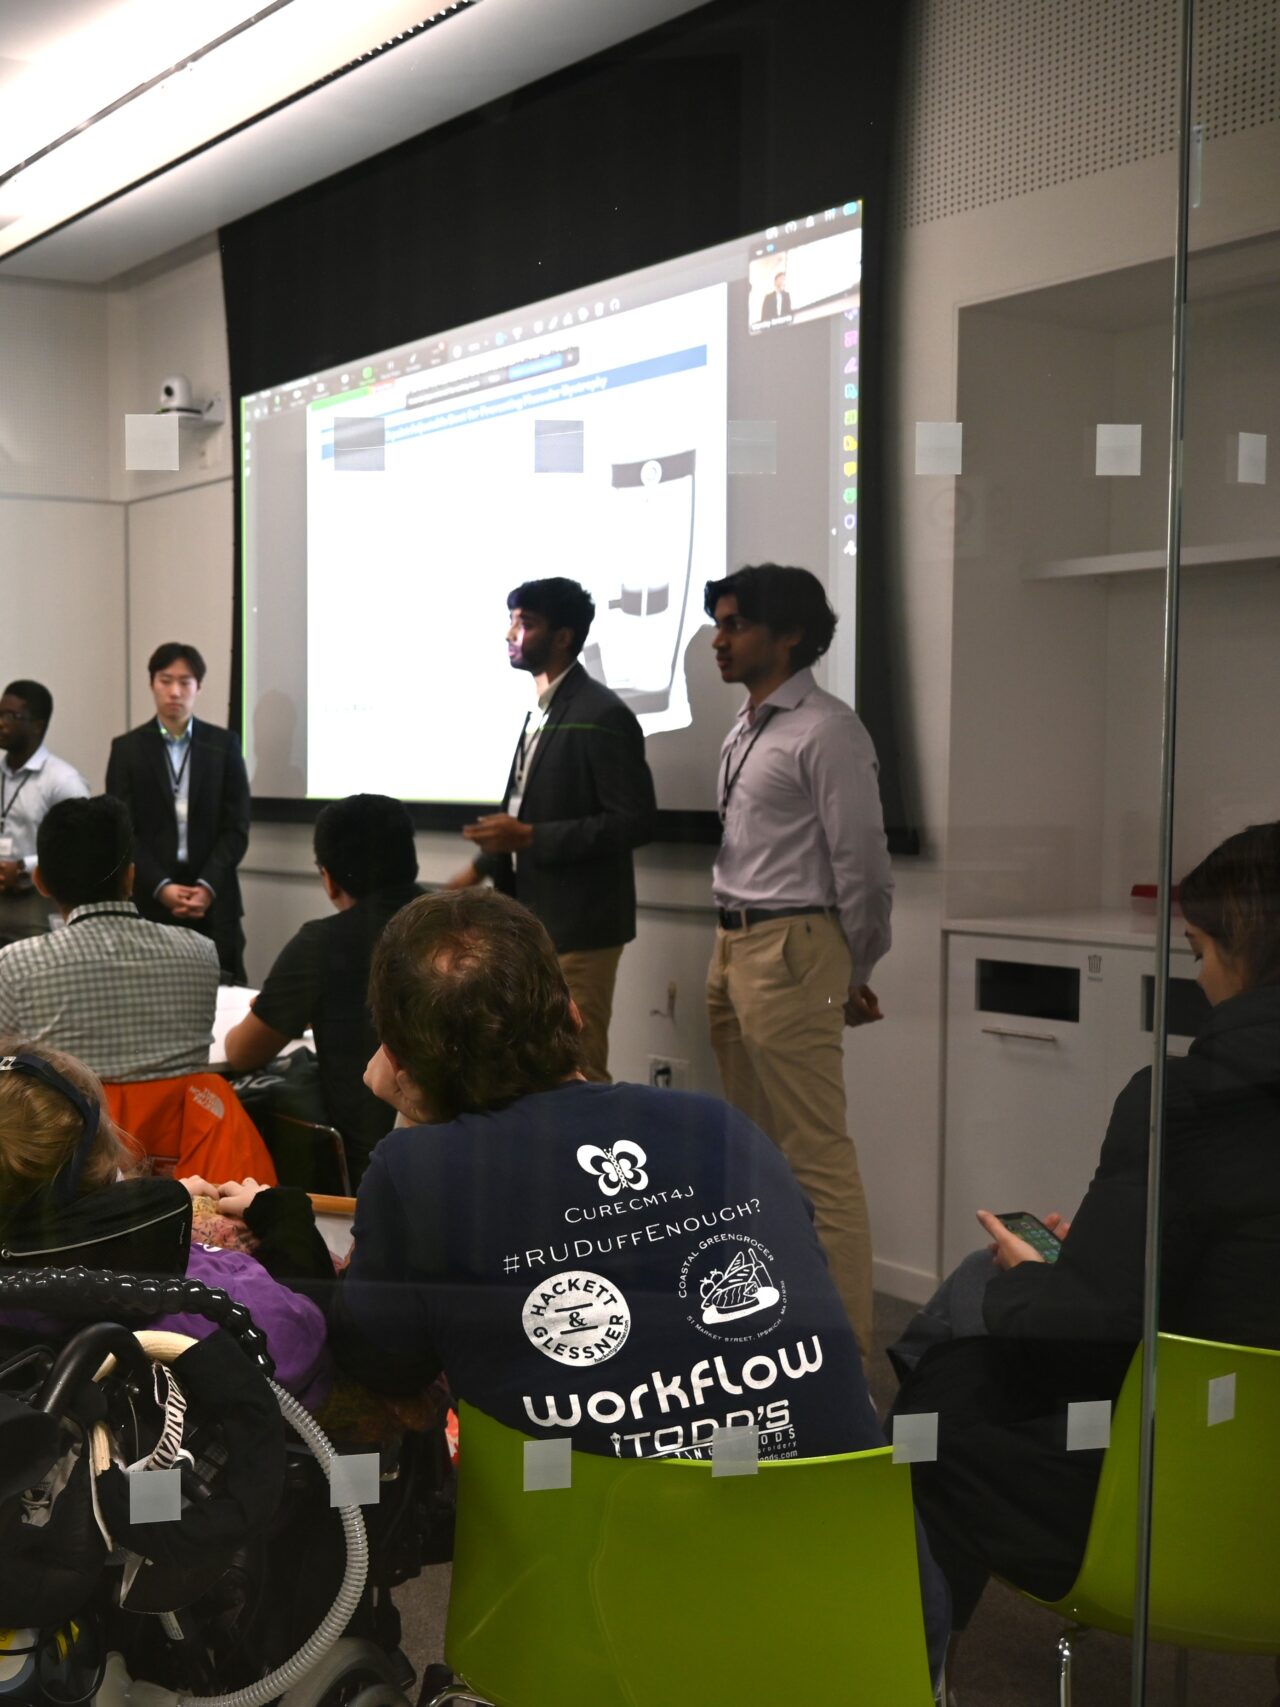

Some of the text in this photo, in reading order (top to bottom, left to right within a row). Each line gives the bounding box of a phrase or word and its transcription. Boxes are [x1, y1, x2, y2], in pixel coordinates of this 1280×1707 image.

[678, 1233, 774, 1298] COASTAL GREENGROCER
[530, 1278, 618, 1316] HACKETT
[533, 1314, 624, 1360] GLESSNER
[568, 1311, 588, 1328] &
